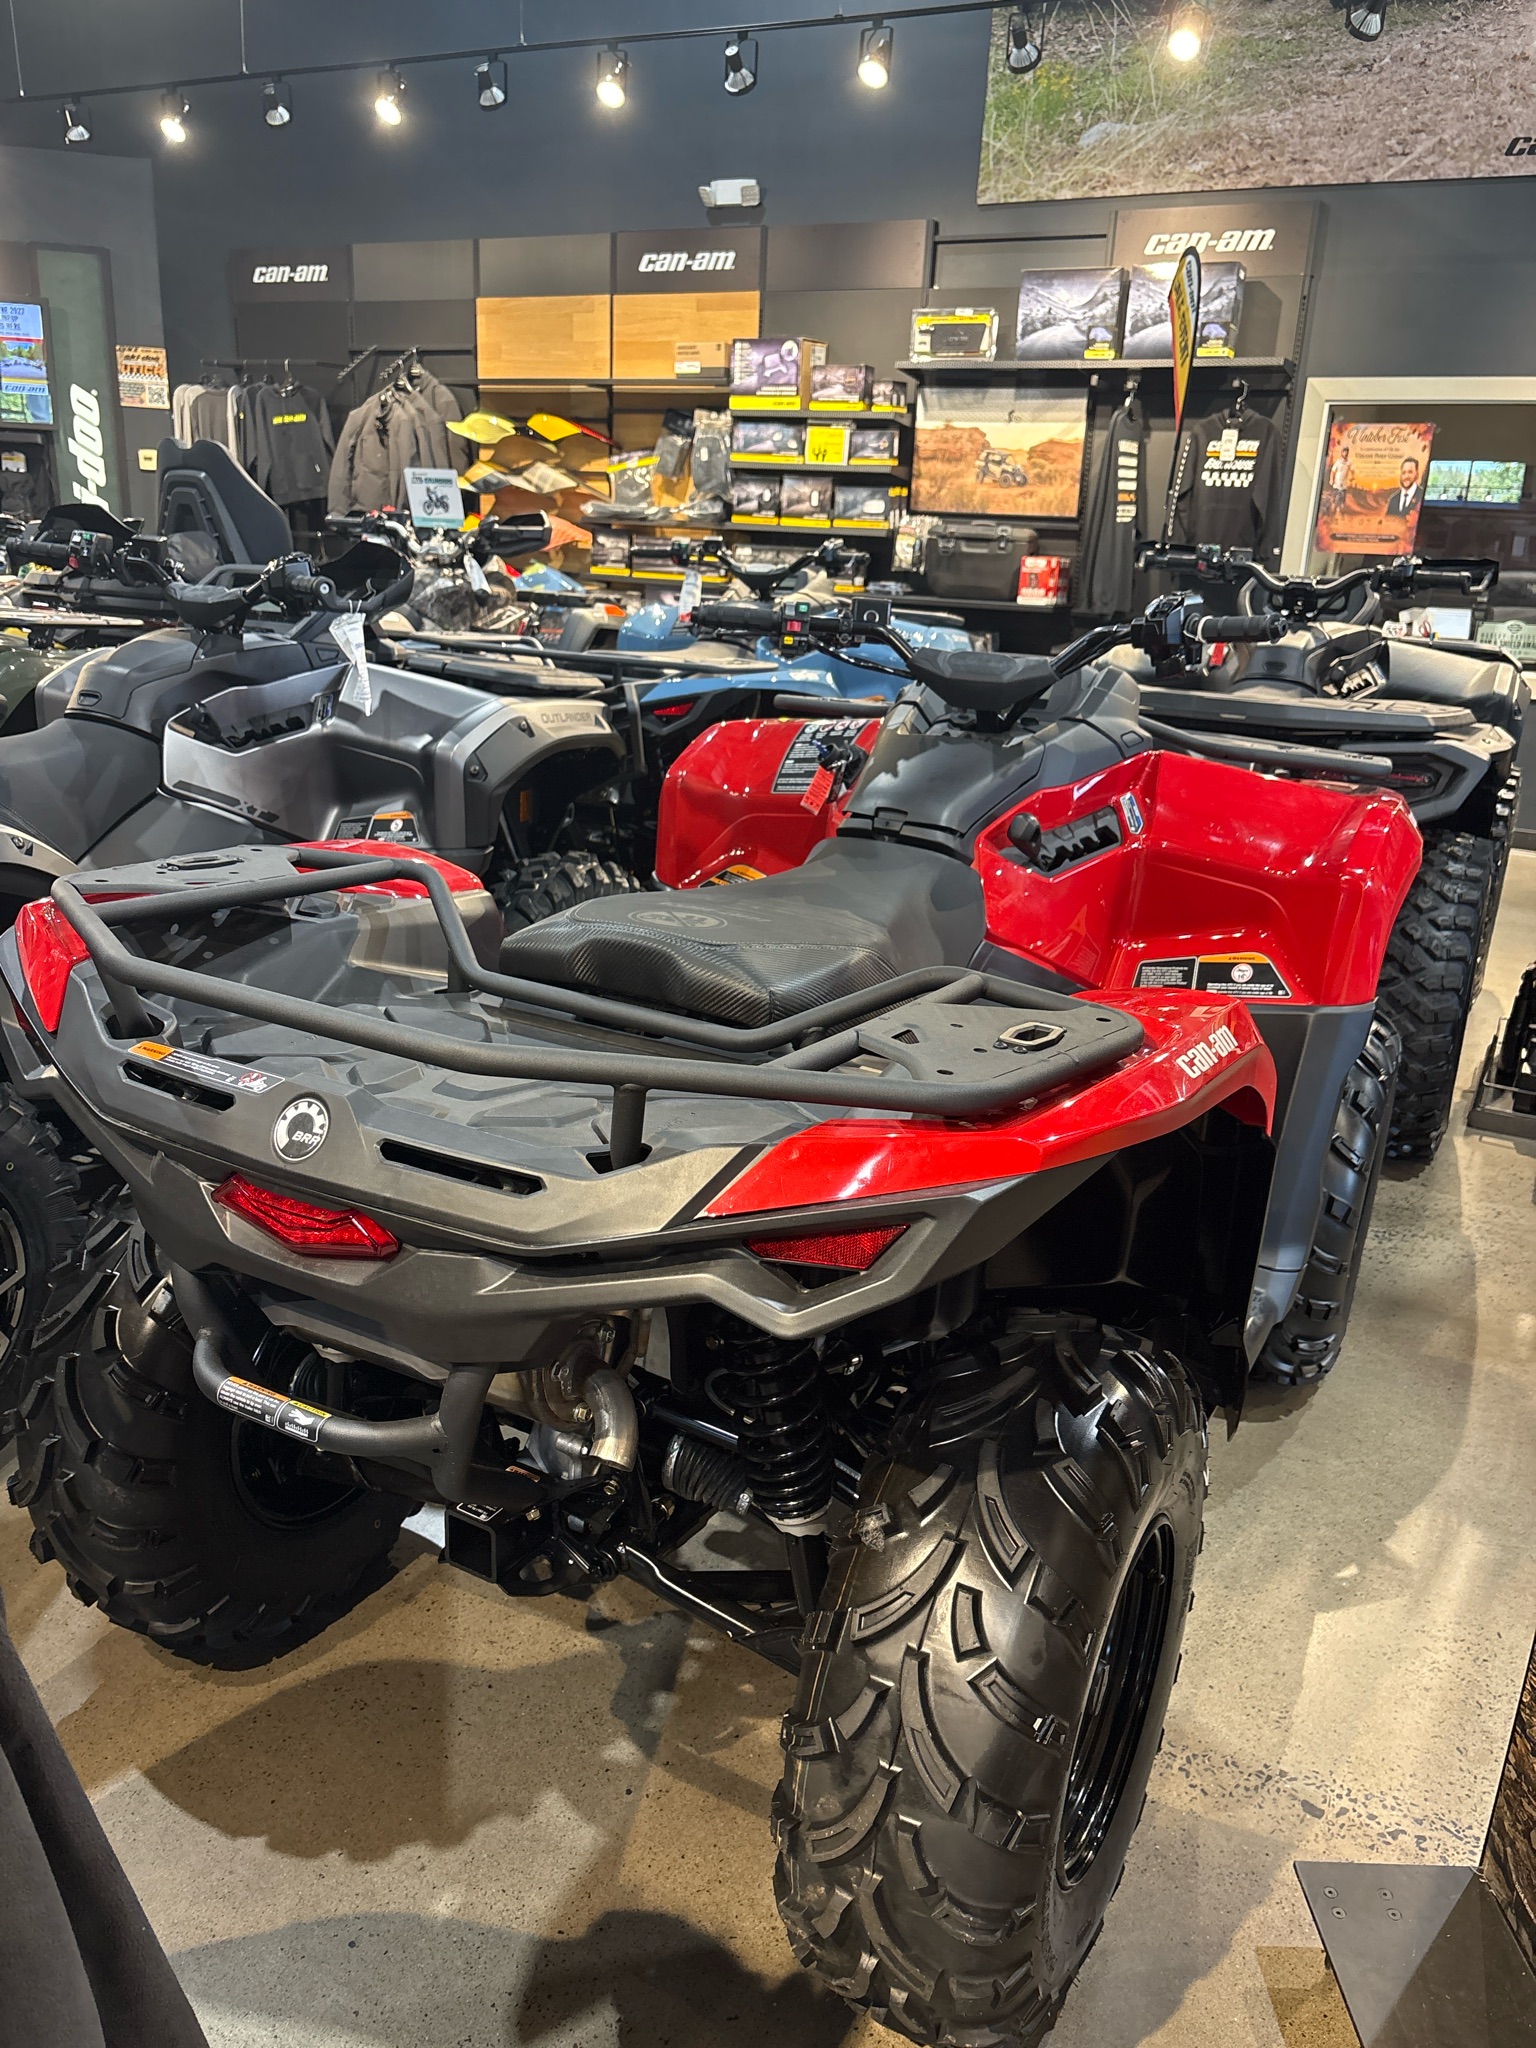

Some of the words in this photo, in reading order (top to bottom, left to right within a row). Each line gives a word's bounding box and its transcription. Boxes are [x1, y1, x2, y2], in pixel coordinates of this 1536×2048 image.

[1144, 229, 1276, 256] can-am
[638, 250, 736, 272] can-am
[252, 265, 329, 283] can-am
[540, 712, 592, 724] OUTLANDER
[1175, 1025, 1239, 1079] can-am
